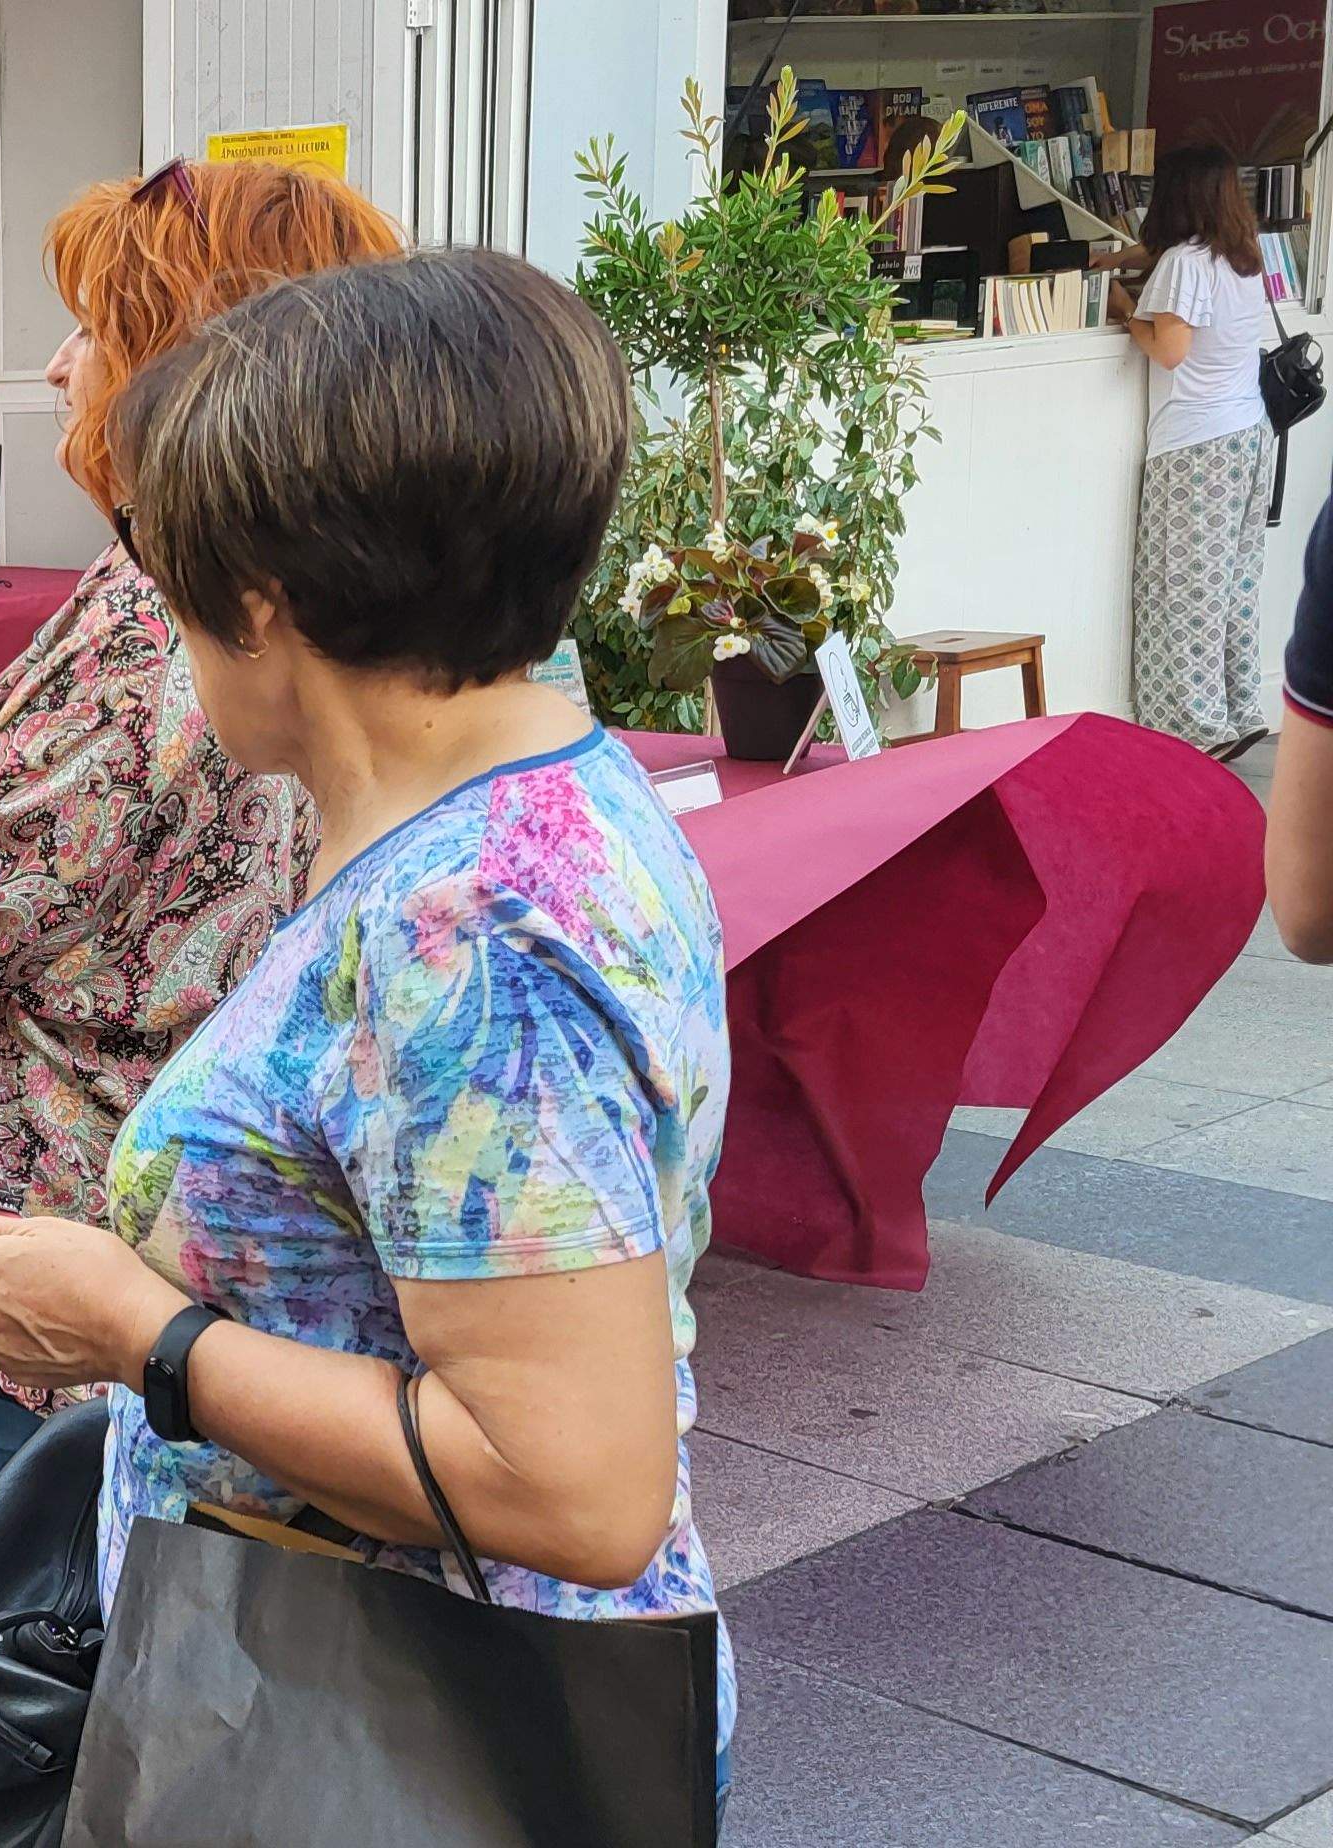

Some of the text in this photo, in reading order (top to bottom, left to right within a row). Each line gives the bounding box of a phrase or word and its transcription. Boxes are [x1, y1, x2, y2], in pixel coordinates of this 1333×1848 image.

[892, 93, 912, 103] BOB
[978, 97, 1019, 112] DIFERENTE
[885, 105, 918, 117] DYLAN
[297, 141, 330, 153] LECTURA
